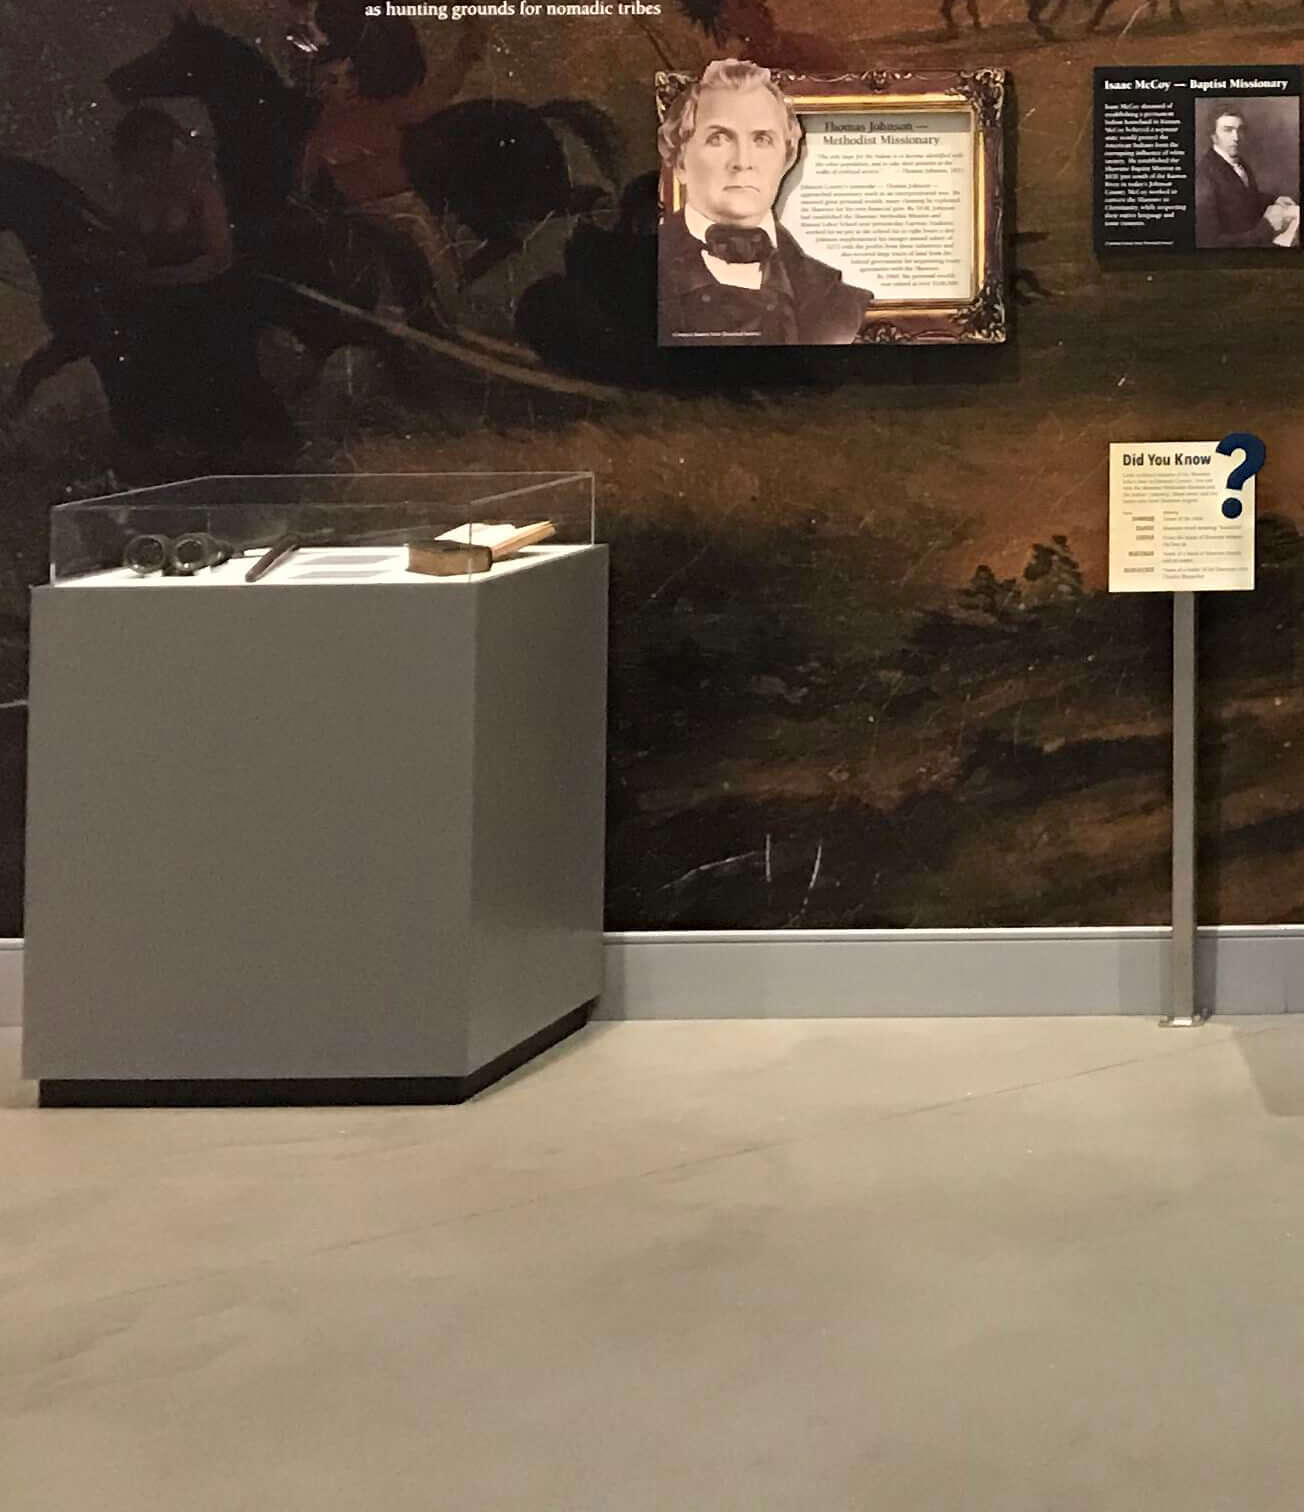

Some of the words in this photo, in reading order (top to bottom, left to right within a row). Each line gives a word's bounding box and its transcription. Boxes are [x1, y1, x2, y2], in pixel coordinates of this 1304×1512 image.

[365, 6, 382, 16] as
[386, 1, 448, 20] hunting
[452, 1, 515, 20] grounds
[520, 1, 542, 16] for
[547, 1, 613, 15] nomadic
[618, 1, 661, 15] tribes
[1104, 80, 1132, 90] Isaac
[1135, 80, 1171, 91] McCoy
[1190, 79, 1226, 91] Baptist
[1230, 79, 1288, 90] Missionary
[825, 121, 866, 132] Thomas
[868, 120, 912, 133] Johnson
[823, 134, 877, 145] Methodist
[880, 135, 939, 146] Missionary
[1123, 453, 1144, 466] Did
[1148, 454, 1170, 466] You
[1175, 453, 1211, 466] Know
[1216, 433, 1266, 519] ?
